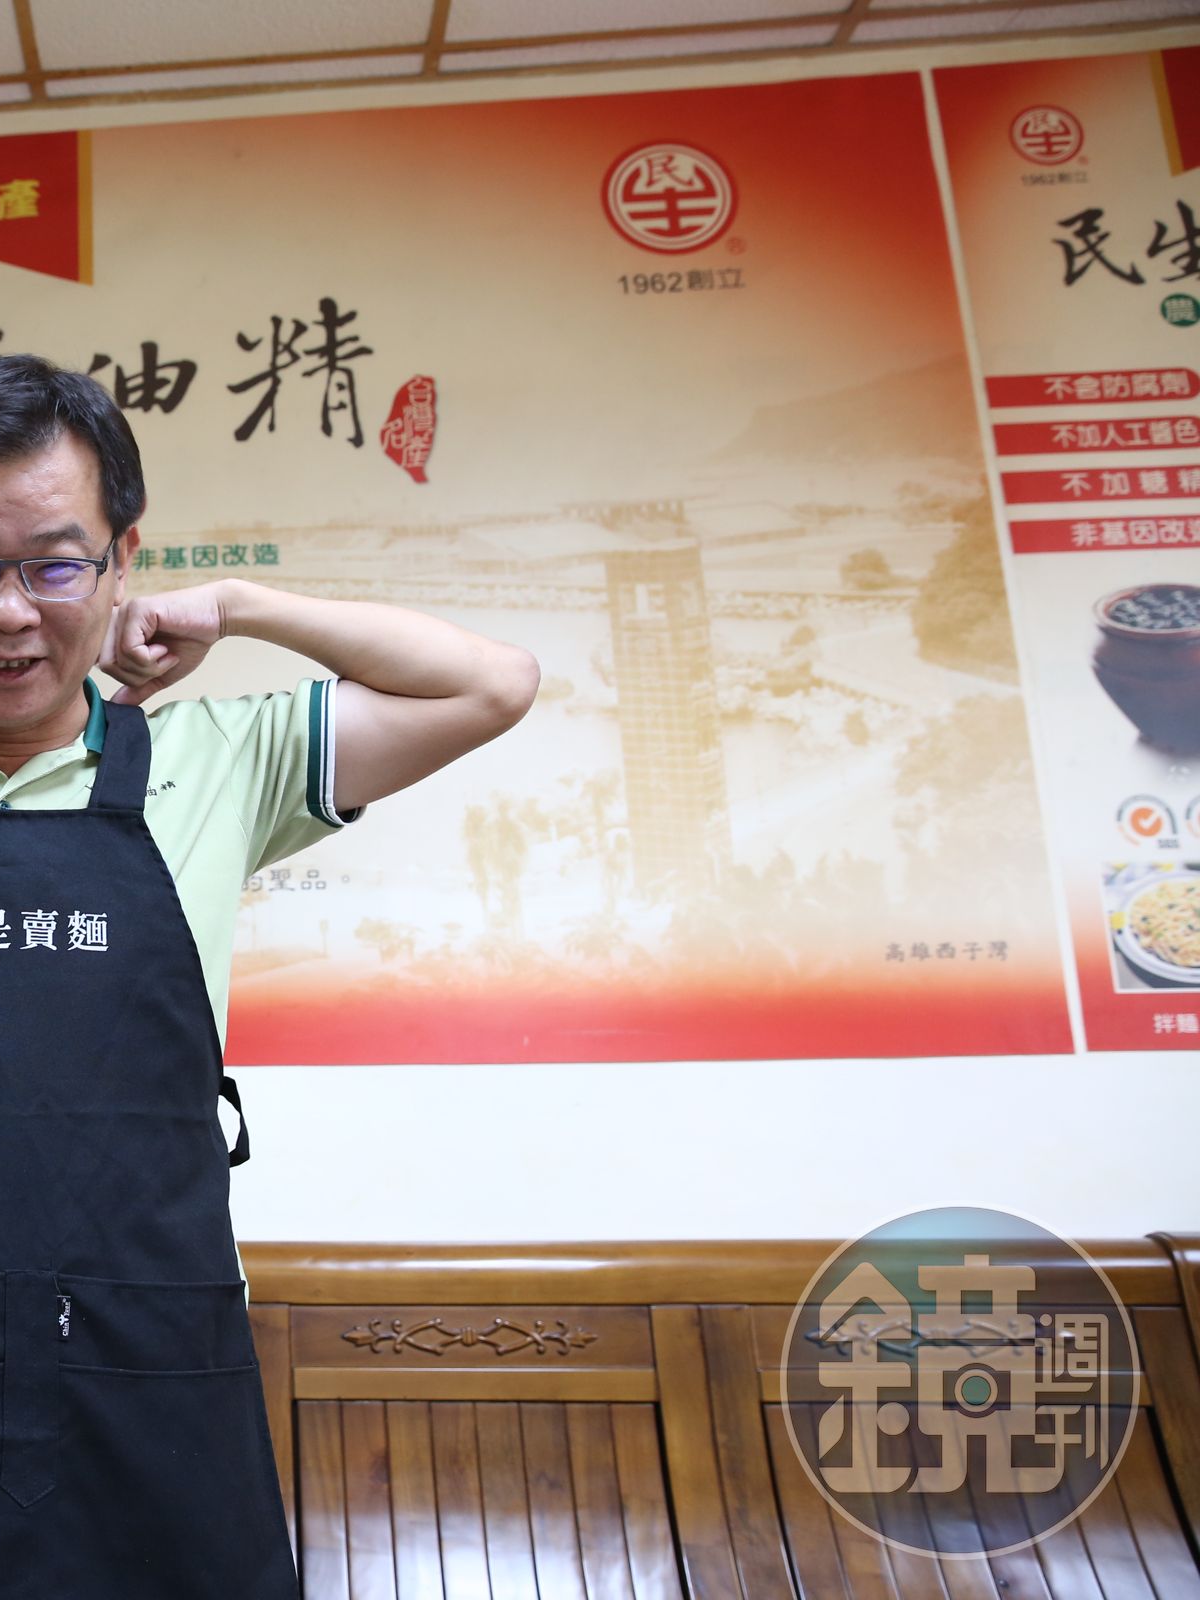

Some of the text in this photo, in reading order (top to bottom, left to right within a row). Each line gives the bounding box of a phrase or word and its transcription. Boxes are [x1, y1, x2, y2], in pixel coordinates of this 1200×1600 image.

[618, 267, 746, 295] 1962創立
[1044, 371, 1191, 400] 不含防腐劑
[133, 543, 280, 571] 非基因改造
[885, 941, 1009, 963] 高雄西子灣
